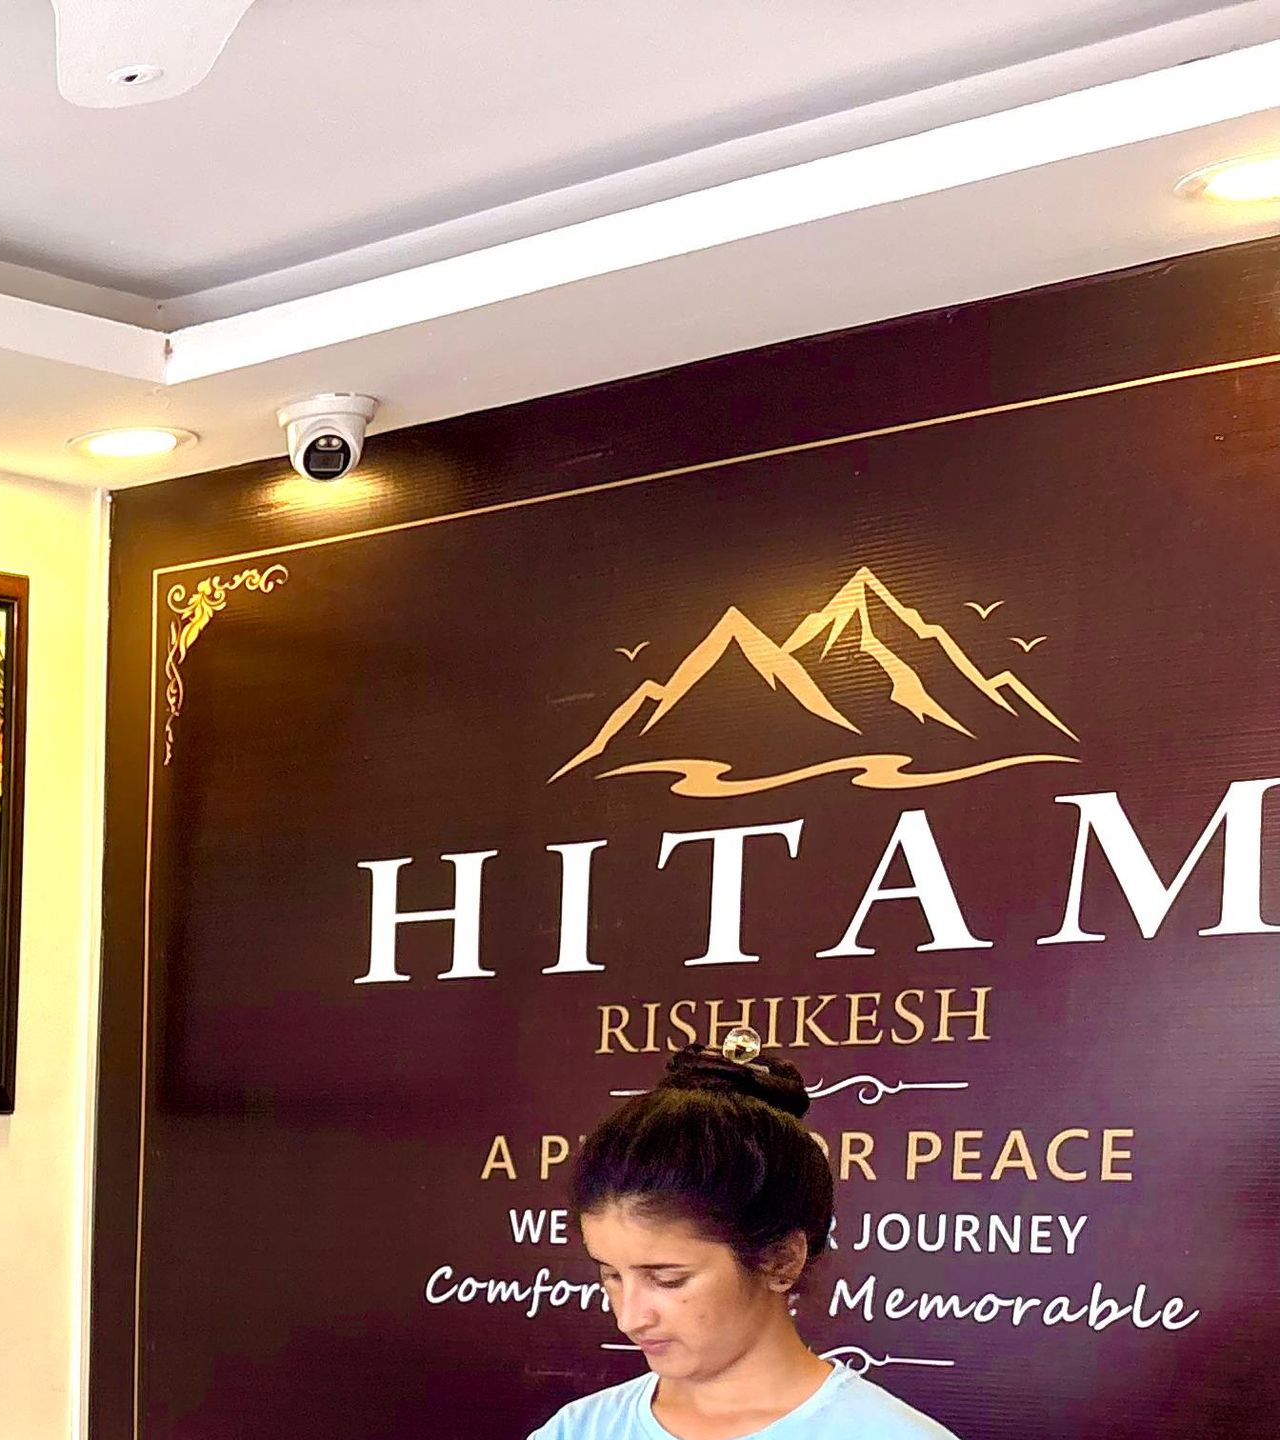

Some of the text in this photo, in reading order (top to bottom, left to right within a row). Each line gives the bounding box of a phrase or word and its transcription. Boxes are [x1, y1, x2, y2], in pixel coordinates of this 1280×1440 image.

[353, 777, 1280, 986] HITAM
[595, 986, 993, 1054] RISHIKESH
[481, 1135, 517, 1180] A
[905, 1128, 1135, 1182] PEACE
[509, 1208, 568, 1244] WE
[853, 1212, 1090, 1254] JOURNEY
[827, 1275, 1200, 1331] Memorable
